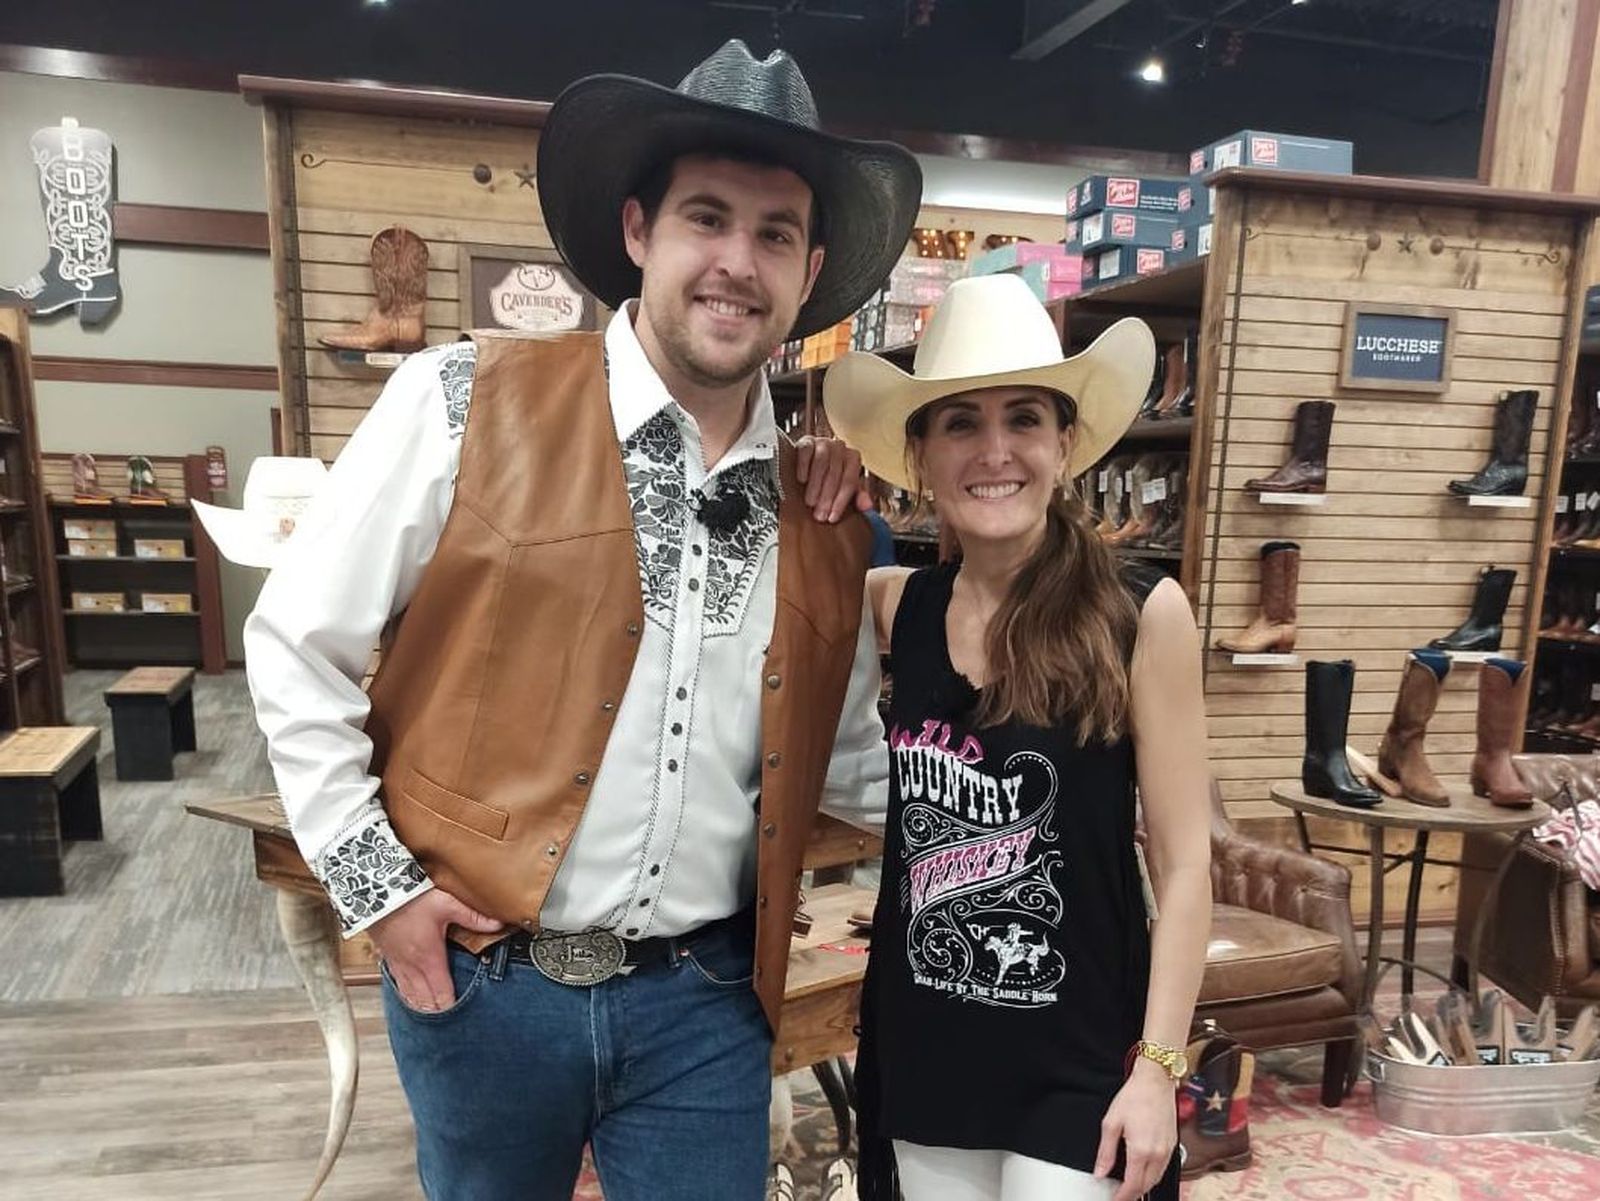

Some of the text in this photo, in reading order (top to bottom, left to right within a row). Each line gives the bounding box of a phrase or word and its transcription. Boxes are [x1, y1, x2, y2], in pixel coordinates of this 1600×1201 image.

[62, 133, 94, 290] BOOTS
[1356, 335, 1441, 354] LUCCHESE
[889, 718, 984, 764] WILD
[897, 744, 1023, 825] COUNTRY
[909, 825, 1038, 915] WHISKEY
